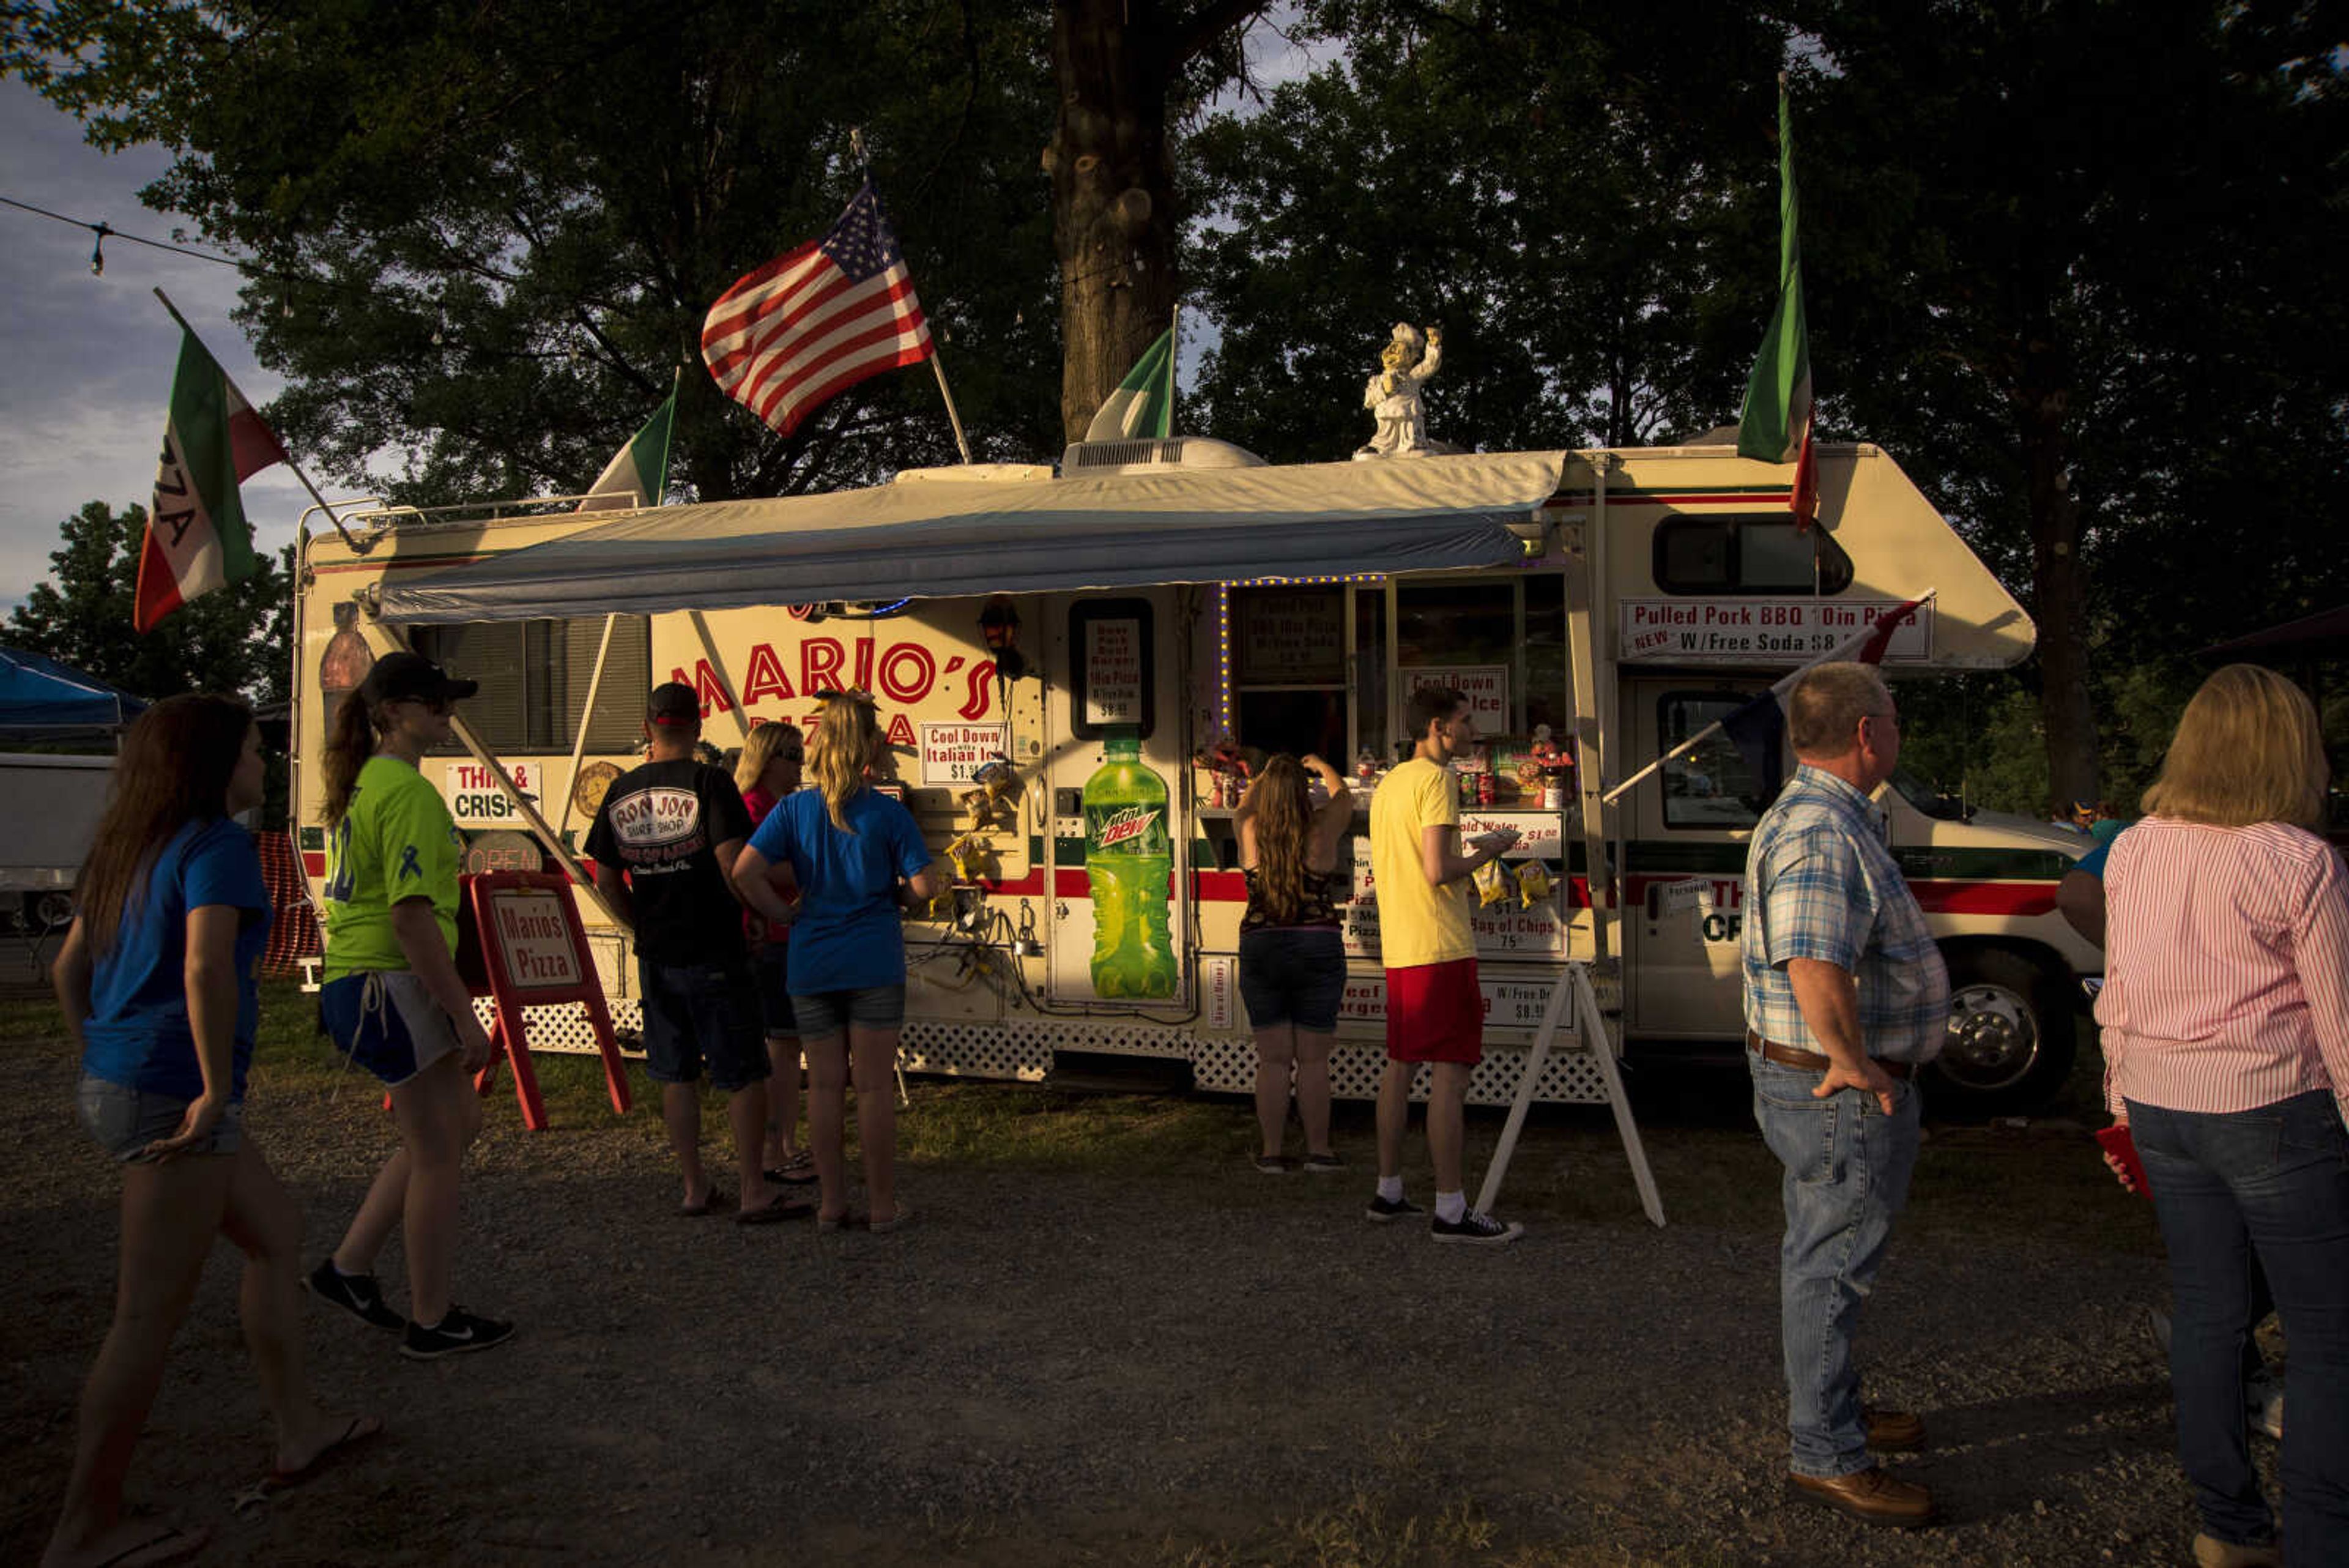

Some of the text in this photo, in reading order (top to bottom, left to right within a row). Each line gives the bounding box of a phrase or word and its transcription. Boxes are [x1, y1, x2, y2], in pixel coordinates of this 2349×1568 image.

[1635, 606, 1696, 625] Pulled
[1705, 606, 1751, 625] Pork
[1762, 607, 1802, 625] BBQ
[1865, 607, 1915, 625] Pia
[1635, 631, 1668, 648] NEW
[1681, 633, 1750, 650] W/Free
[1757, 633, 1803, 650] Soda
[670, 637, 997, 721] MARIO'S
[1452, 675, 1493, 690] Down
[1472, 695, 1500, 711] Ice
[932, 728, 998, 743] Cool Down
[927, 746, 975, 762] Italian
[459, 766, 528, 789] THI &
[617, 796, 694, 830] RON JON
[628, 819, 684, 838] SURF SHOP
[1460, 823, 1478, 832] old
[1346, 894, 1378, 905] Pizz
[1501, 918, 1511, 932] of
[1518, 917, 1554, 935] Chips
[516, 948, 570, 979] Pizza
[1346, 985, 1382, 998] eef
